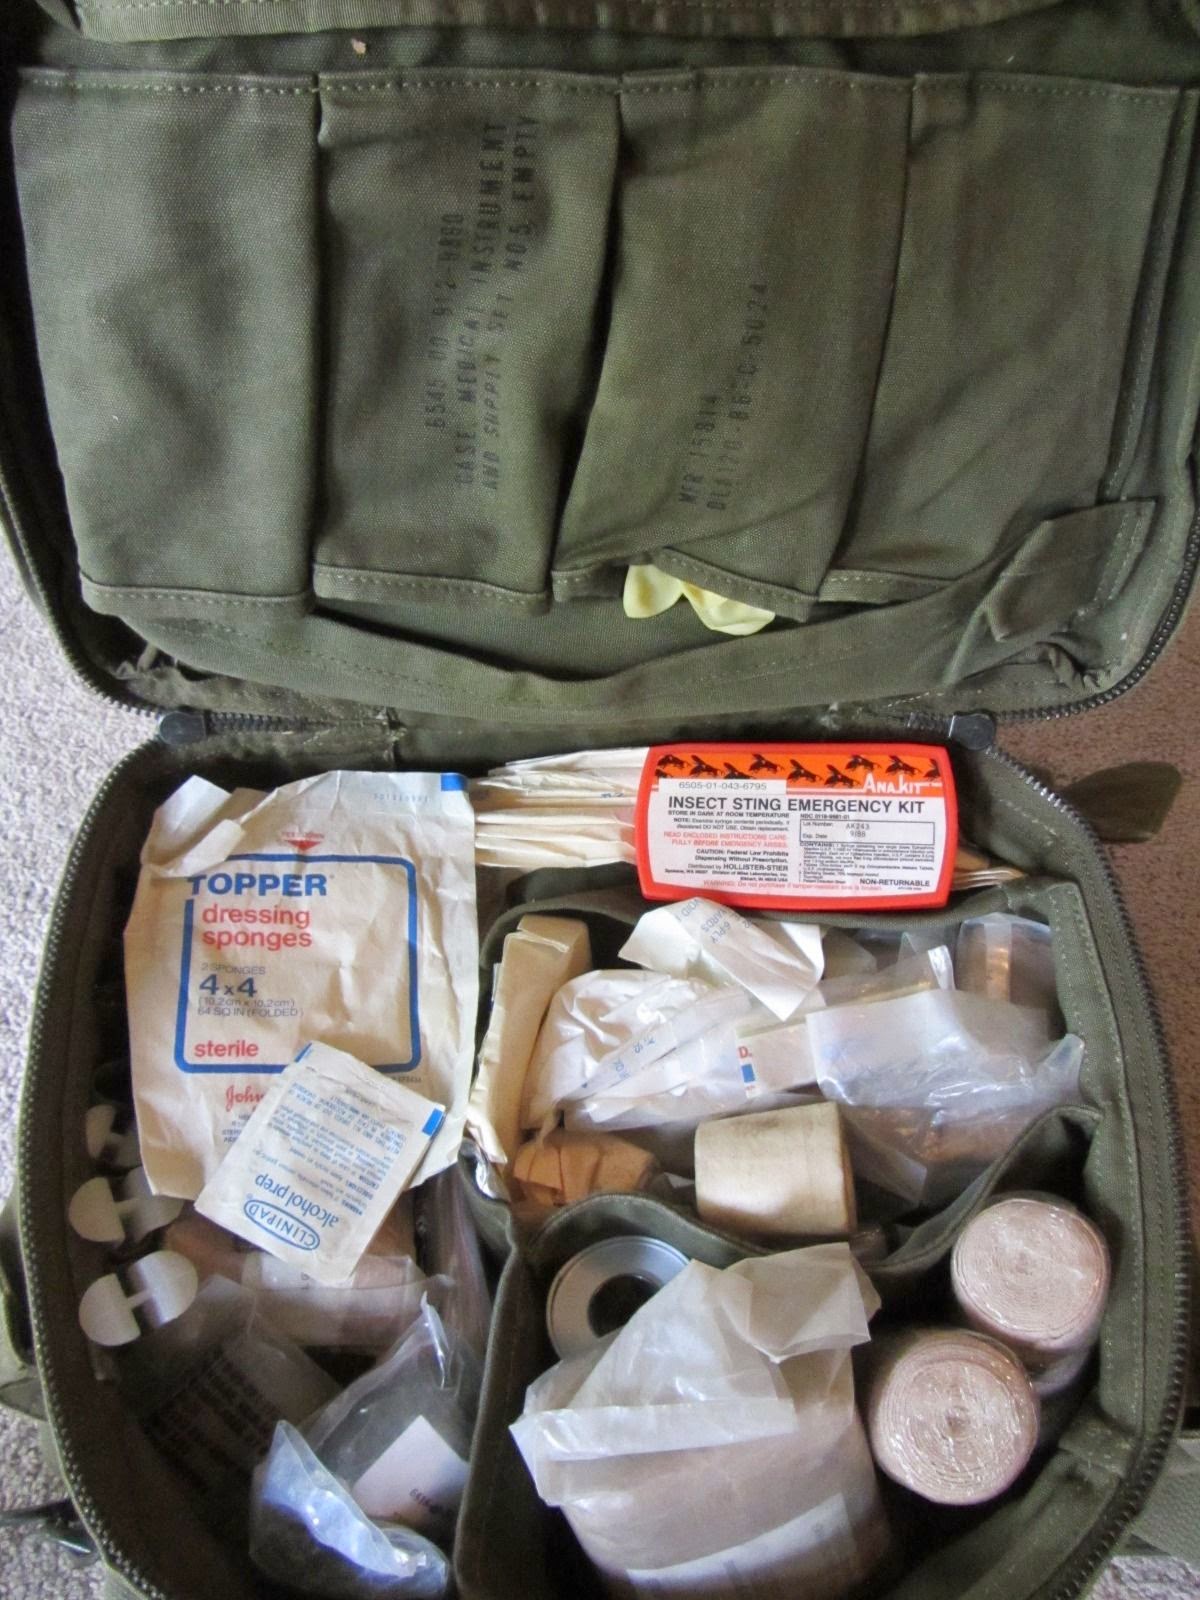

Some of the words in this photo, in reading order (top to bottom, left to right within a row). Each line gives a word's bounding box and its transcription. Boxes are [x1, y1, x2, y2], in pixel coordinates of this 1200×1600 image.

[469, 123, 507, 283] INSTRUMENT
[678, 781, 767, 790] 6505-01-043-6795
[668, 796, 727, 809] INSECT
[732, 798, 781, 811] STING
[788, 798, 892, 813] EMERGENCY
[898, 800, 925, 813] KIT
[187, 873, 327, 896] TOPPER
[860, 878, 930, 887] NON-RETURNABLE
[202, 903, 310, 929] dressing
[202, 929, 312, 951] sponges
[210, 963, 266, 975] SPONGES
[199, 973, 219, 995] 4
[237, 977, 258, 998] 4
[194, 1040, 259, 1057] sterile
[255, 1173, 289, 1200] prep
[286, 1195, 339, 1229] alcohol
[249, 1202, 316, 1247] CLINIPAD
